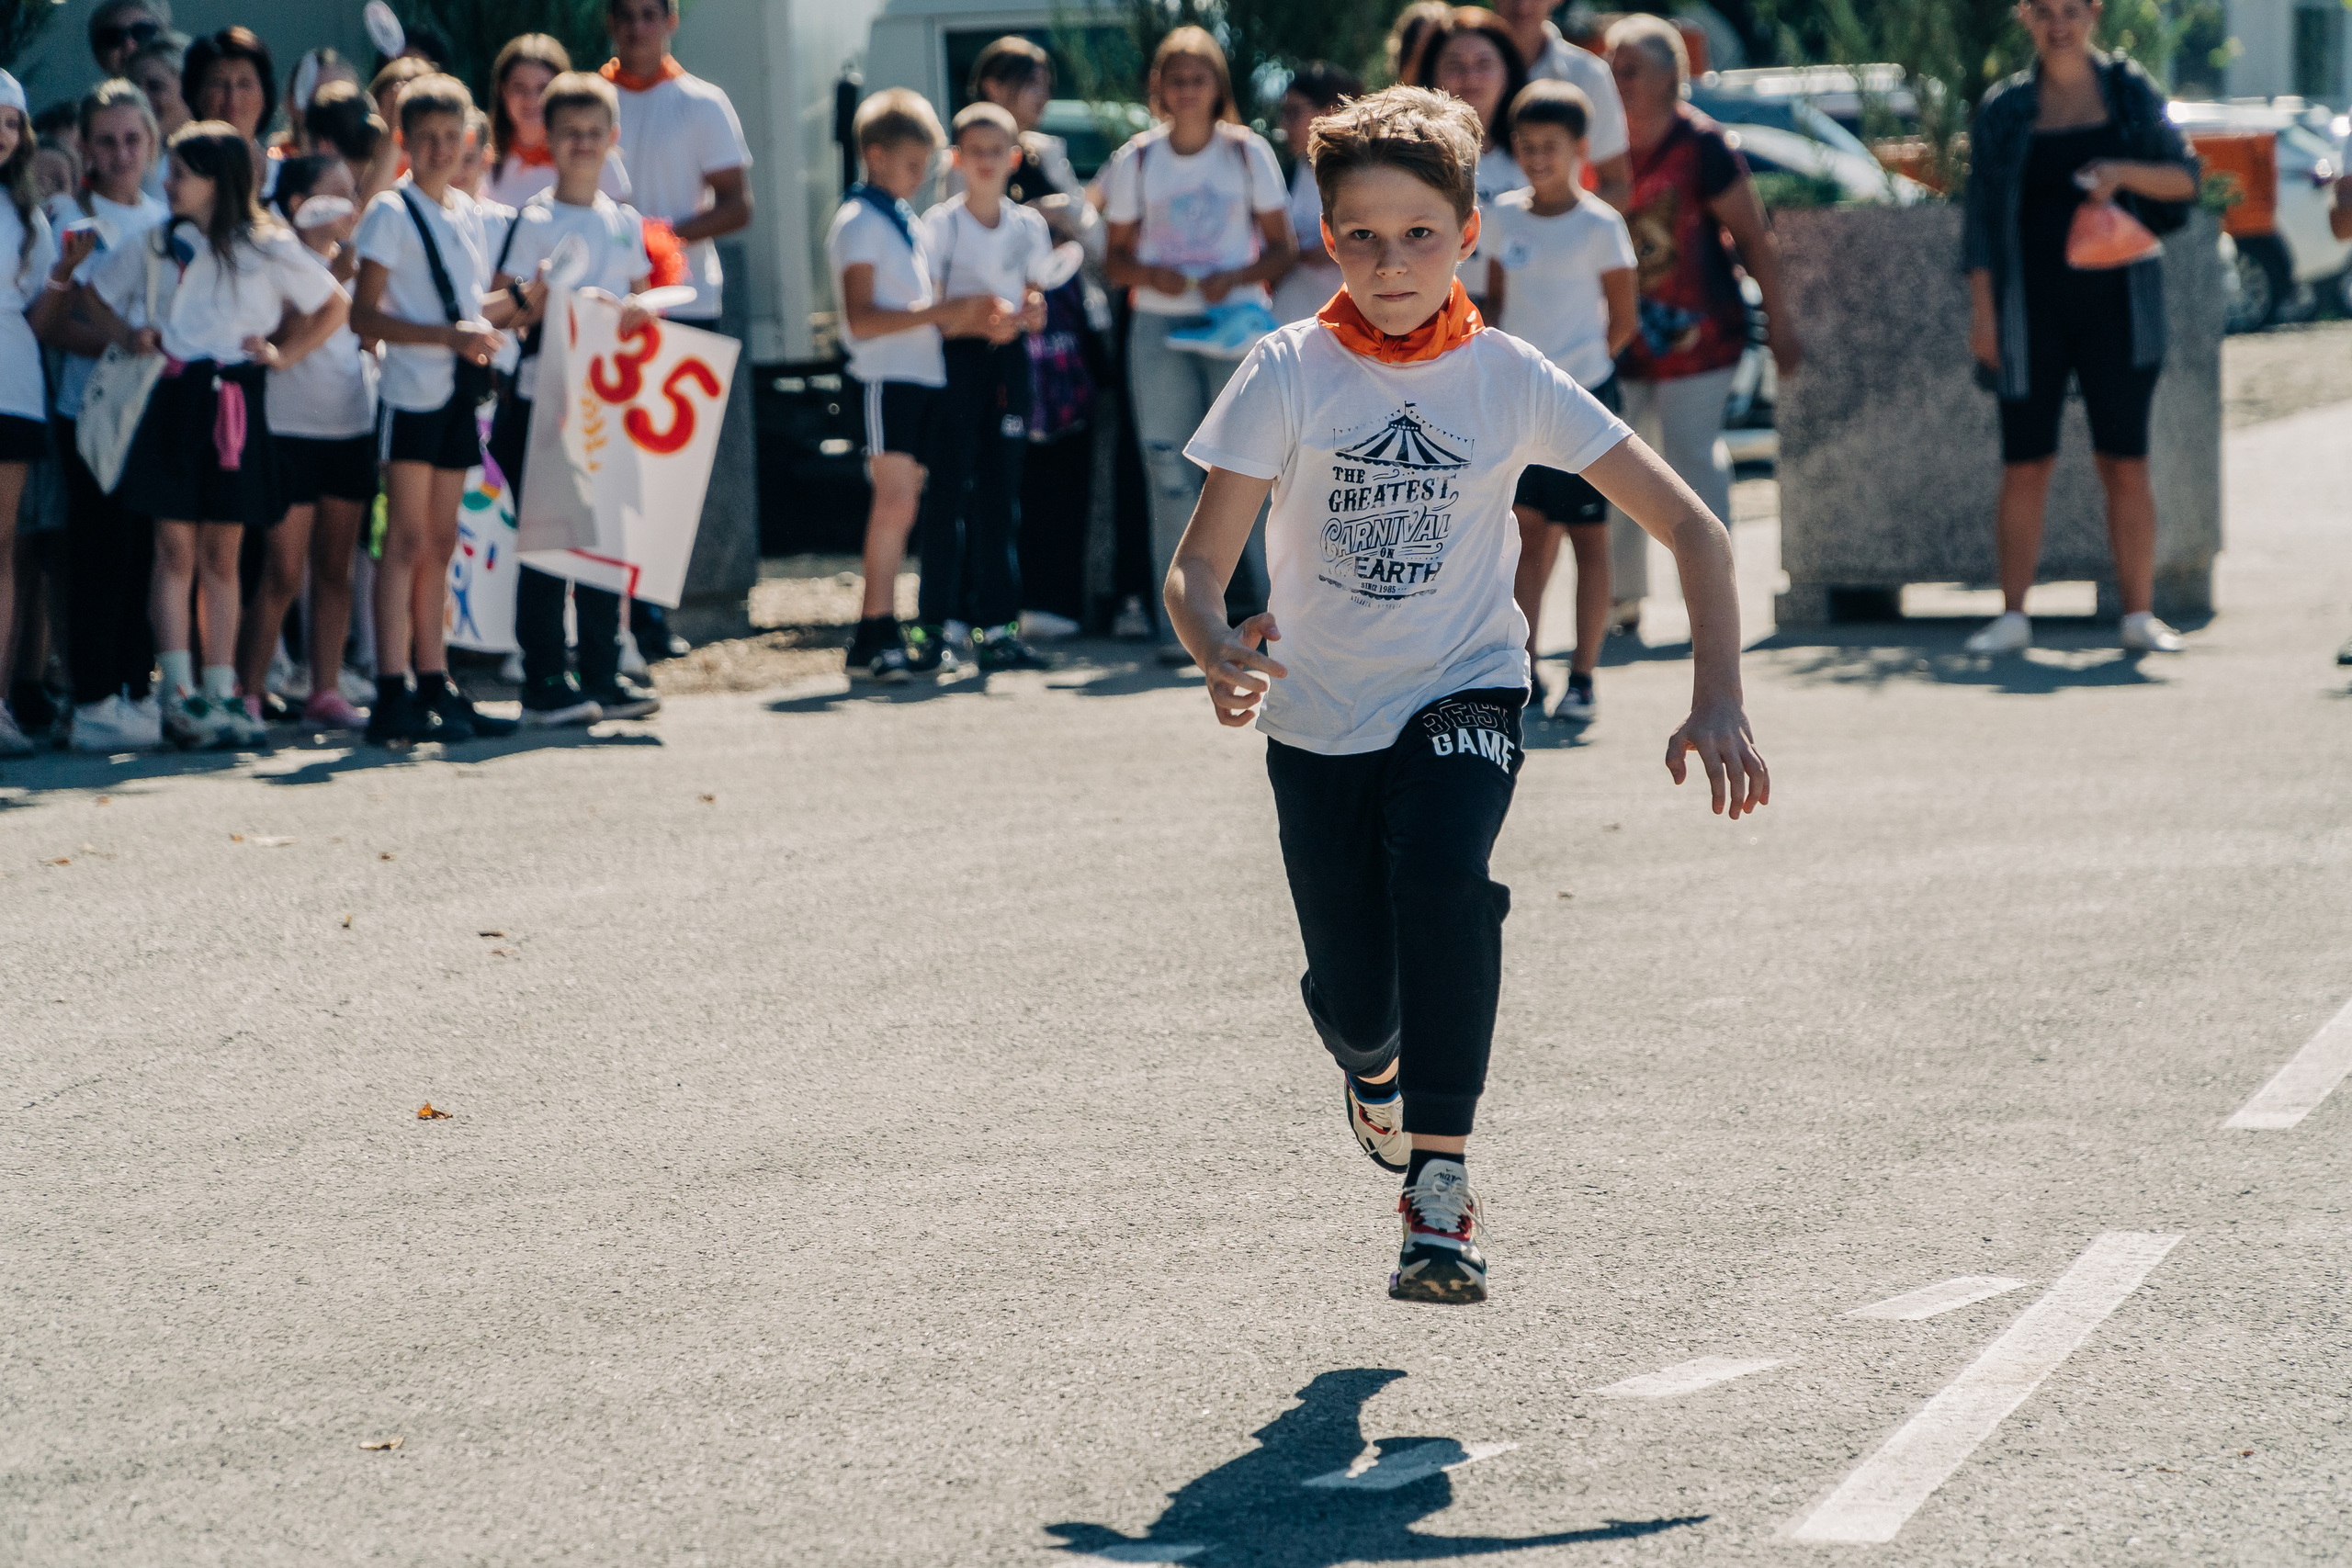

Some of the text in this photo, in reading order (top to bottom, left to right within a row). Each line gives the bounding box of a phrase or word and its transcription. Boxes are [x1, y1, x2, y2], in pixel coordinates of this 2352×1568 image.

[590, 318, 721, 455] 35
[1332, 466, 1365, 484] THE
[1329, 473, 1456, 513] GREATEST
[1320, 504, 1451, 562] CARNIVAL
[1380, 547, 1395, 558] ON
[1355, 556, 1443, 583] EARTH
[1361, 581, 1396, 593] SINCE 1985
[1432, 728, 1515, 774] GAME
